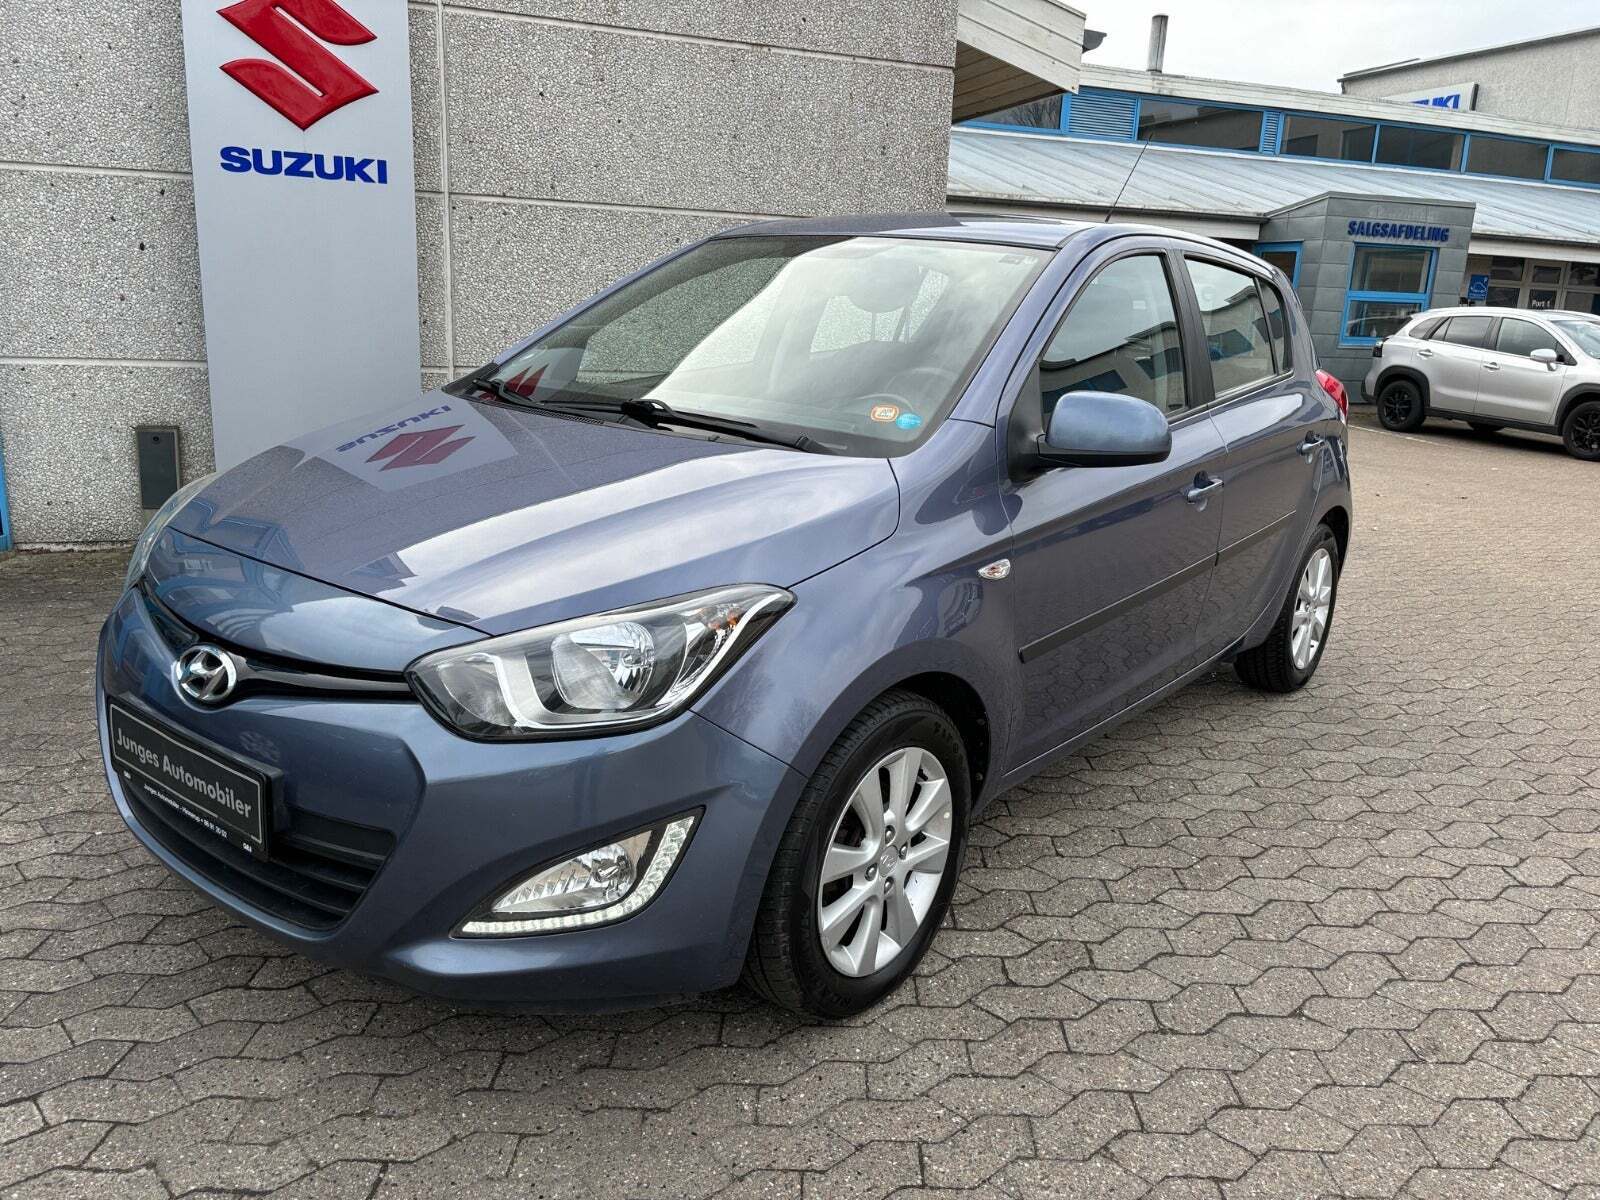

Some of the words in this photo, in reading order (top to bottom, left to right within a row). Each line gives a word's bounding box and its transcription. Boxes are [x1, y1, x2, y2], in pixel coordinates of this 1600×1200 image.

[220, 146, 388, 184] SUZUKI
[1347, 220, 1450, 242] SALGSAFDELING
[116, 728, 160, 766] Junges
[162, 755, 252, 818] Automobiler
